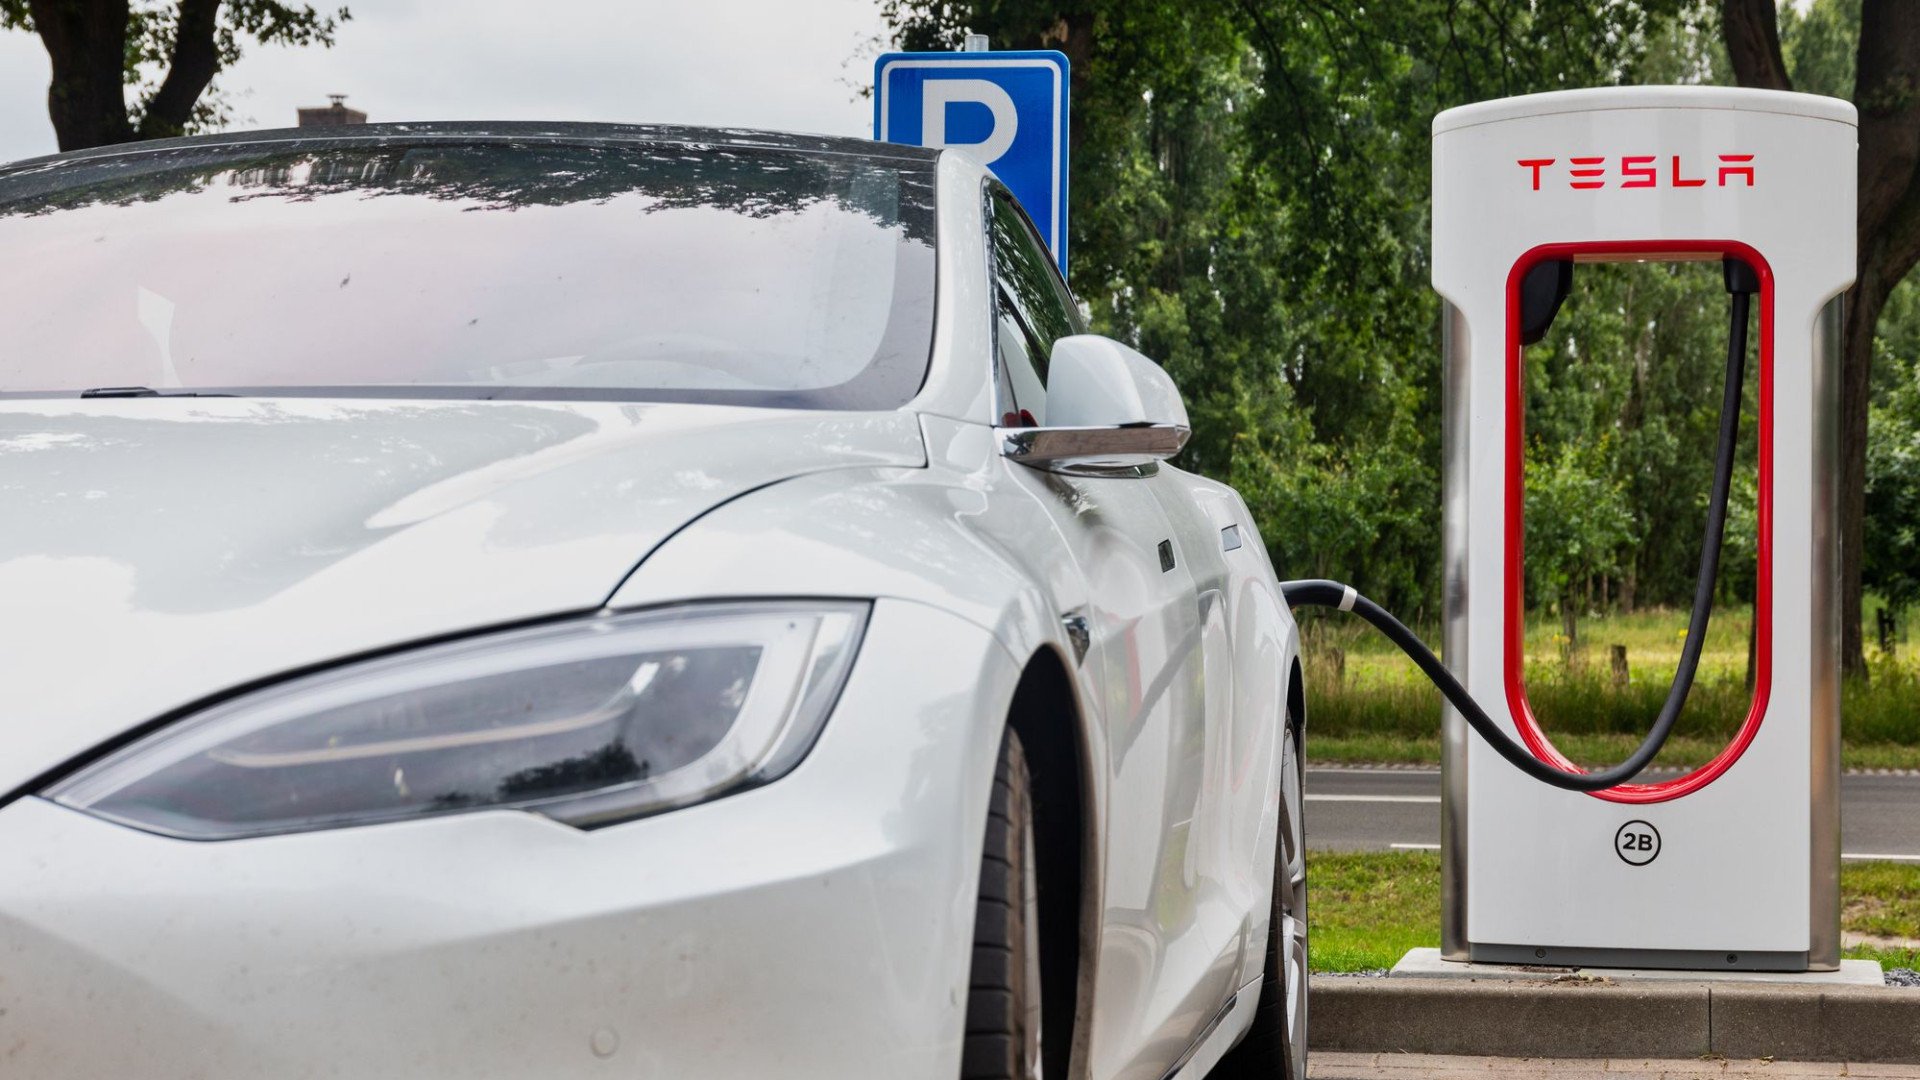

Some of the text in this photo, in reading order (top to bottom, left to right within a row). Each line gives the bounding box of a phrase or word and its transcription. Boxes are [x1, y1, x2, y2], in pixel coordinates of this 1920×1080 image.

[922, 79, 1018, 165] P
[1517, 154, 1755, 191] TESLA
[1622, 832, 1653, 851] 2B
